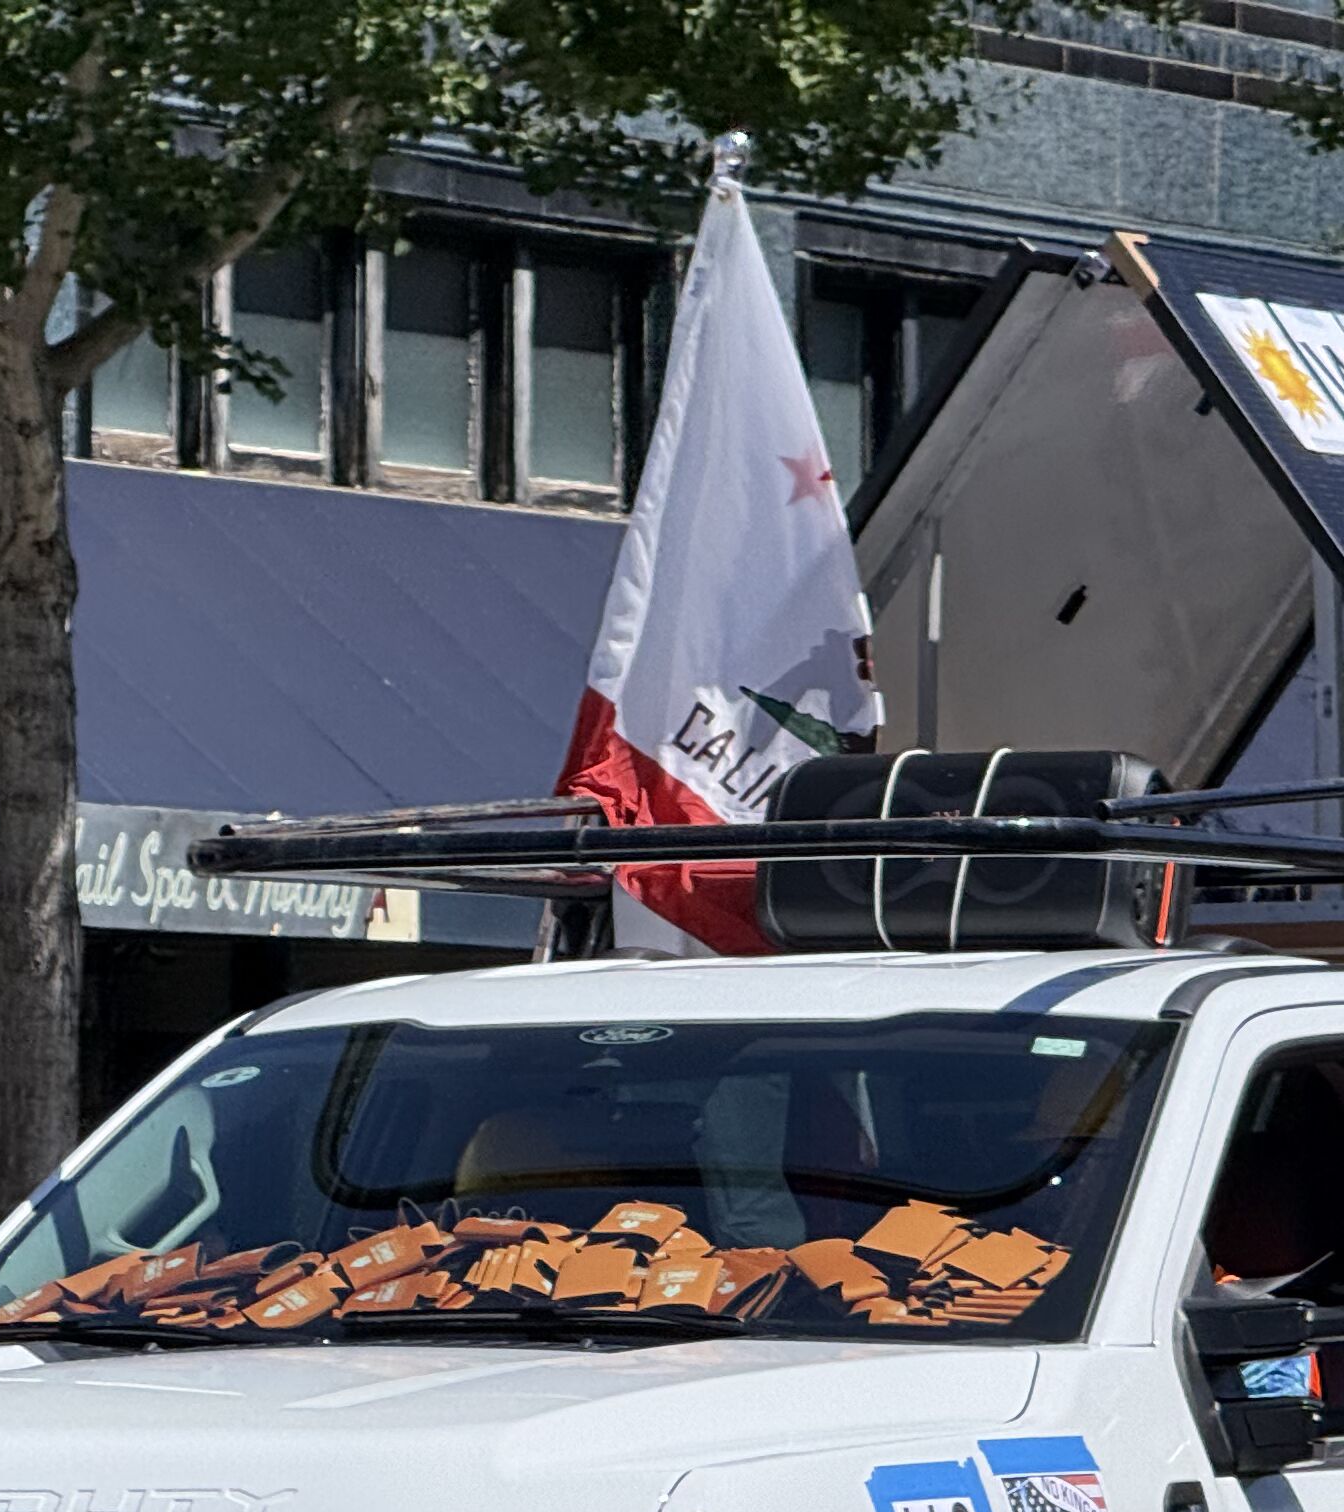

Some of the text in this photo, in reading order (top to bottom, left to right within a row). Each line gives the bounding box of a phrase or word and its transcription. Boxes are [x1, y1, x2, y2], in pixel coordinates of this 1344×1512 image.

[671, 701, 777, 810] CALI
[75, 816, 124, 907] ail
[131, 830, 197, 924] Spa
[1041, 1476, 1060, 1499] NO
